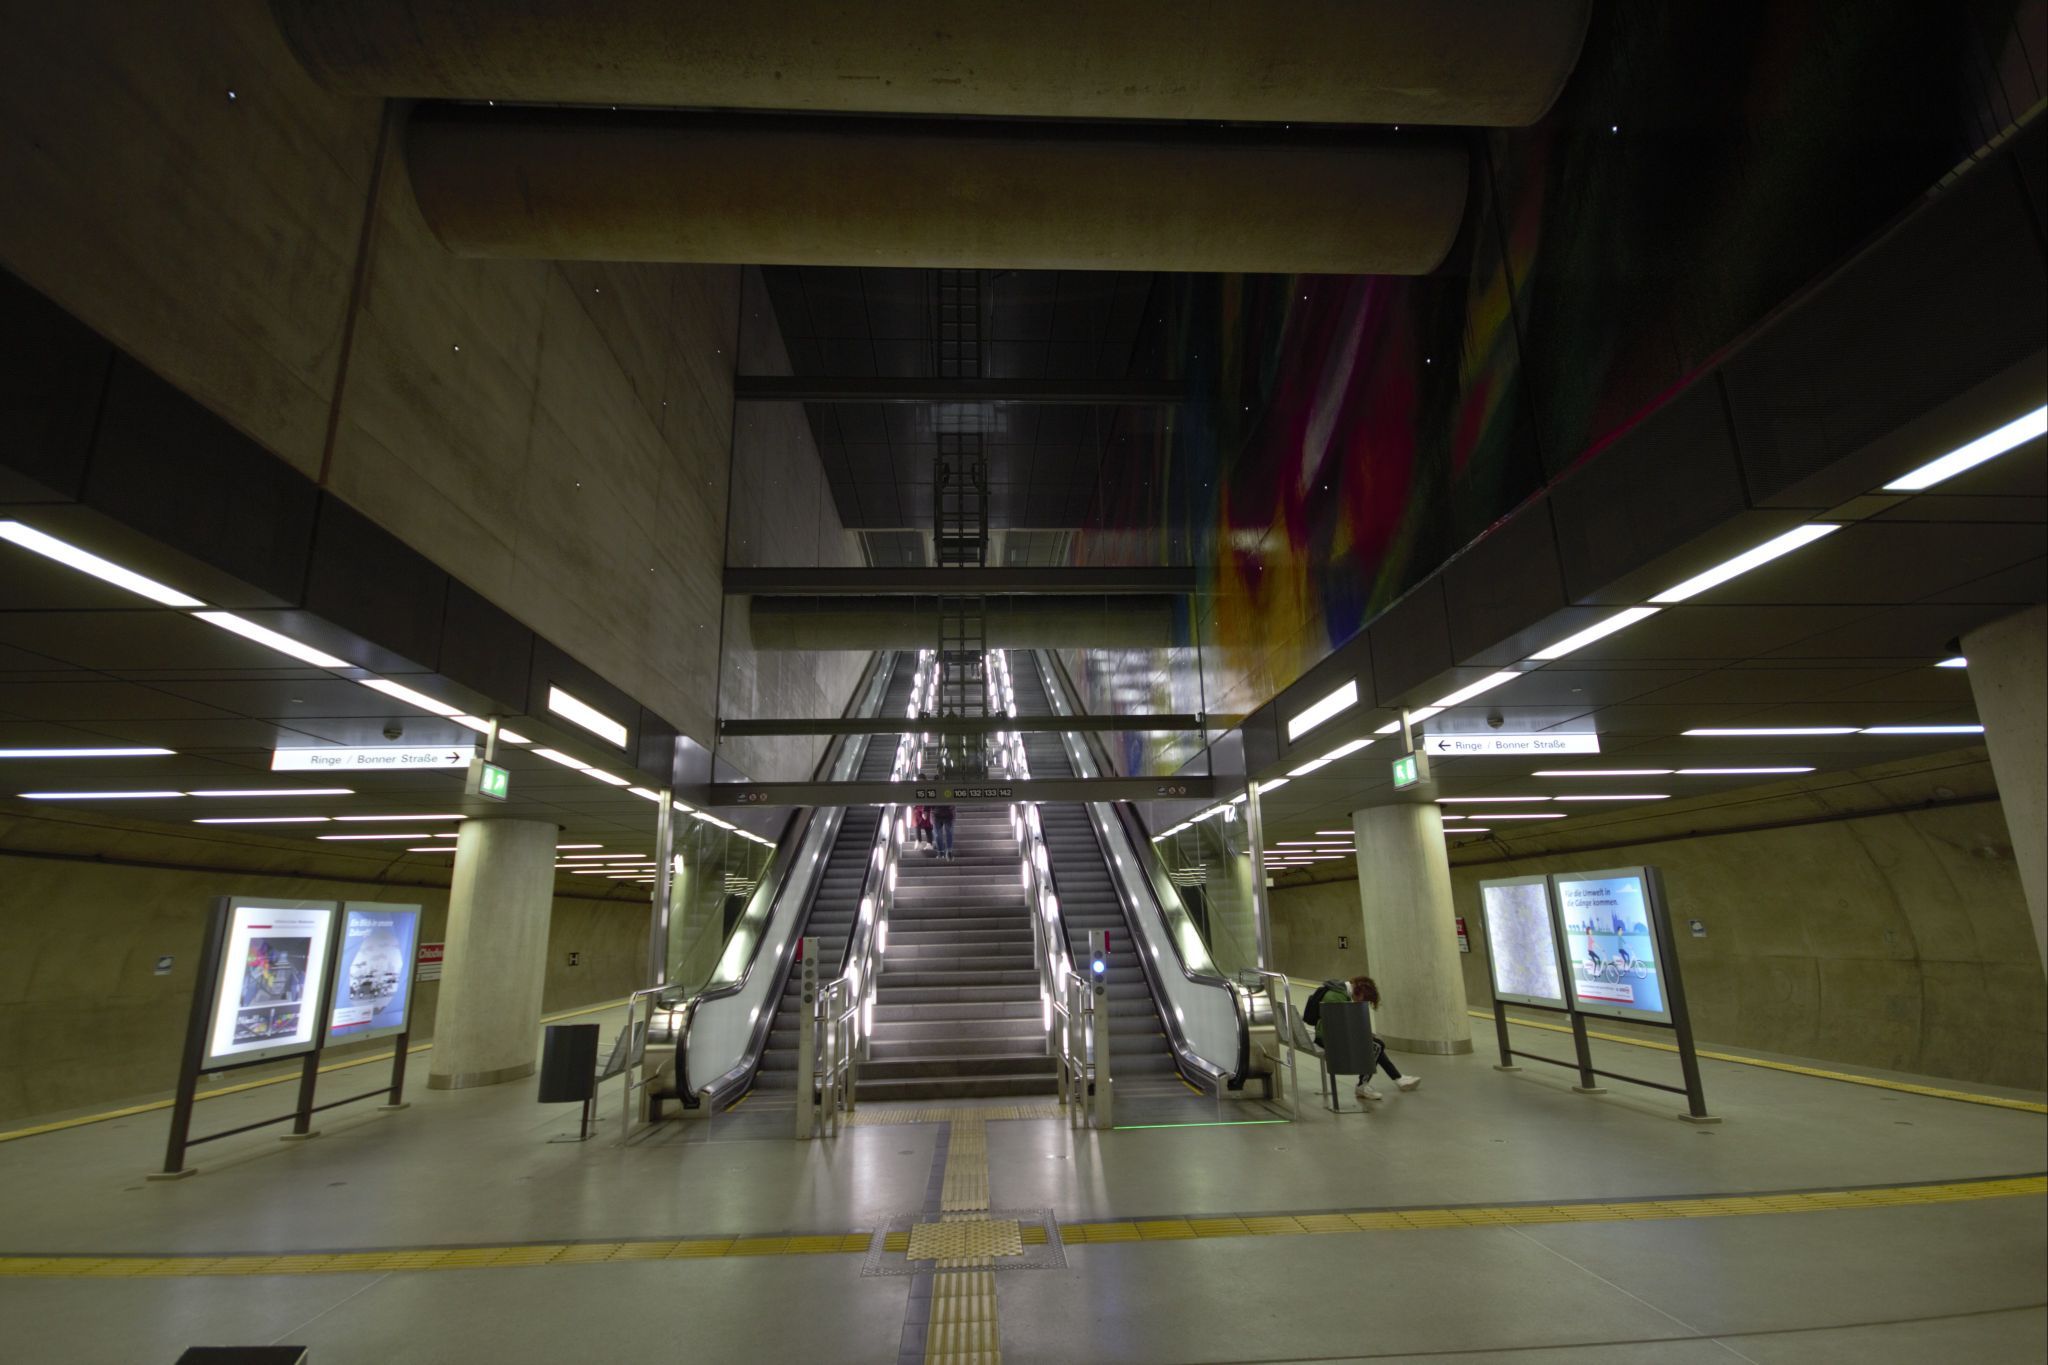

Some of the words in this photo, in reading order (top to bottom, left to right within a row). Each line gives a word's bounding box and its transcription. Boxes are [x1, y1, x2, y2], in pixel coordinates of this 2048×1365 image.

[1455, 741, 1482, 751] Ringe
[1496, 740, 1529, 749] Bonner
[1533, 740, 1566, 749] Straße
[310, 755, 342, 766] Ringe
[357, 754, 397, 764] Bonner
[401, 753, 438, 763] Straße
[1583, 888, 1604, 896] Umwelt
